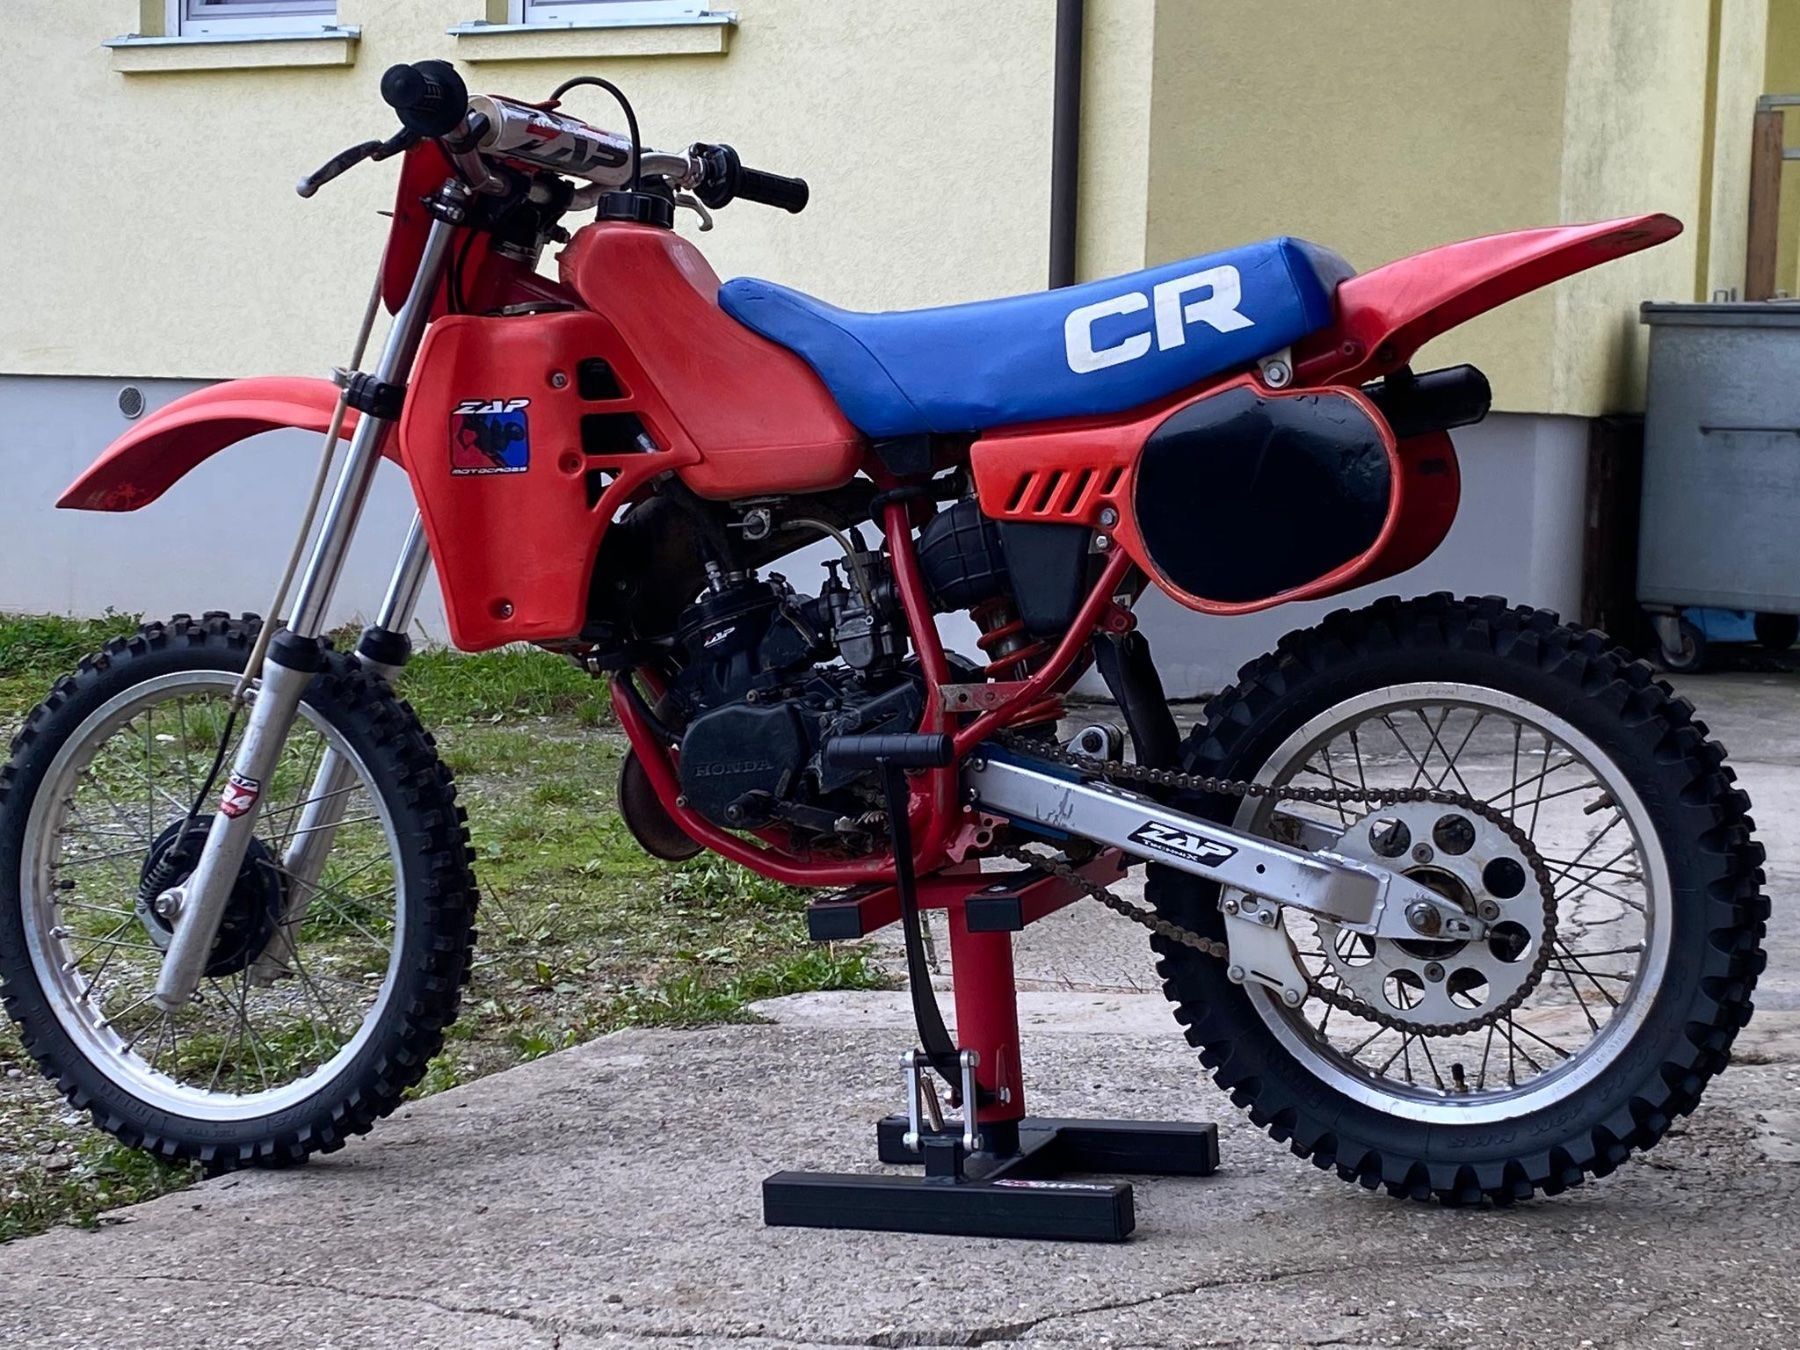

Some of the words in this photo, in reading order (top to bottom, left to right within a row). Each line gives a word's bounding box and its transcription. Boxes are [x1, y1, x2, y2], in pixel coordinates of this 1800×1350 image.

[1064, 264, 1256, 375] CR
[452, 399, 530, 415] ZAP
[695, 759, 775, 777] HONDA
[1136, 822, 1233, 858] ZAP
